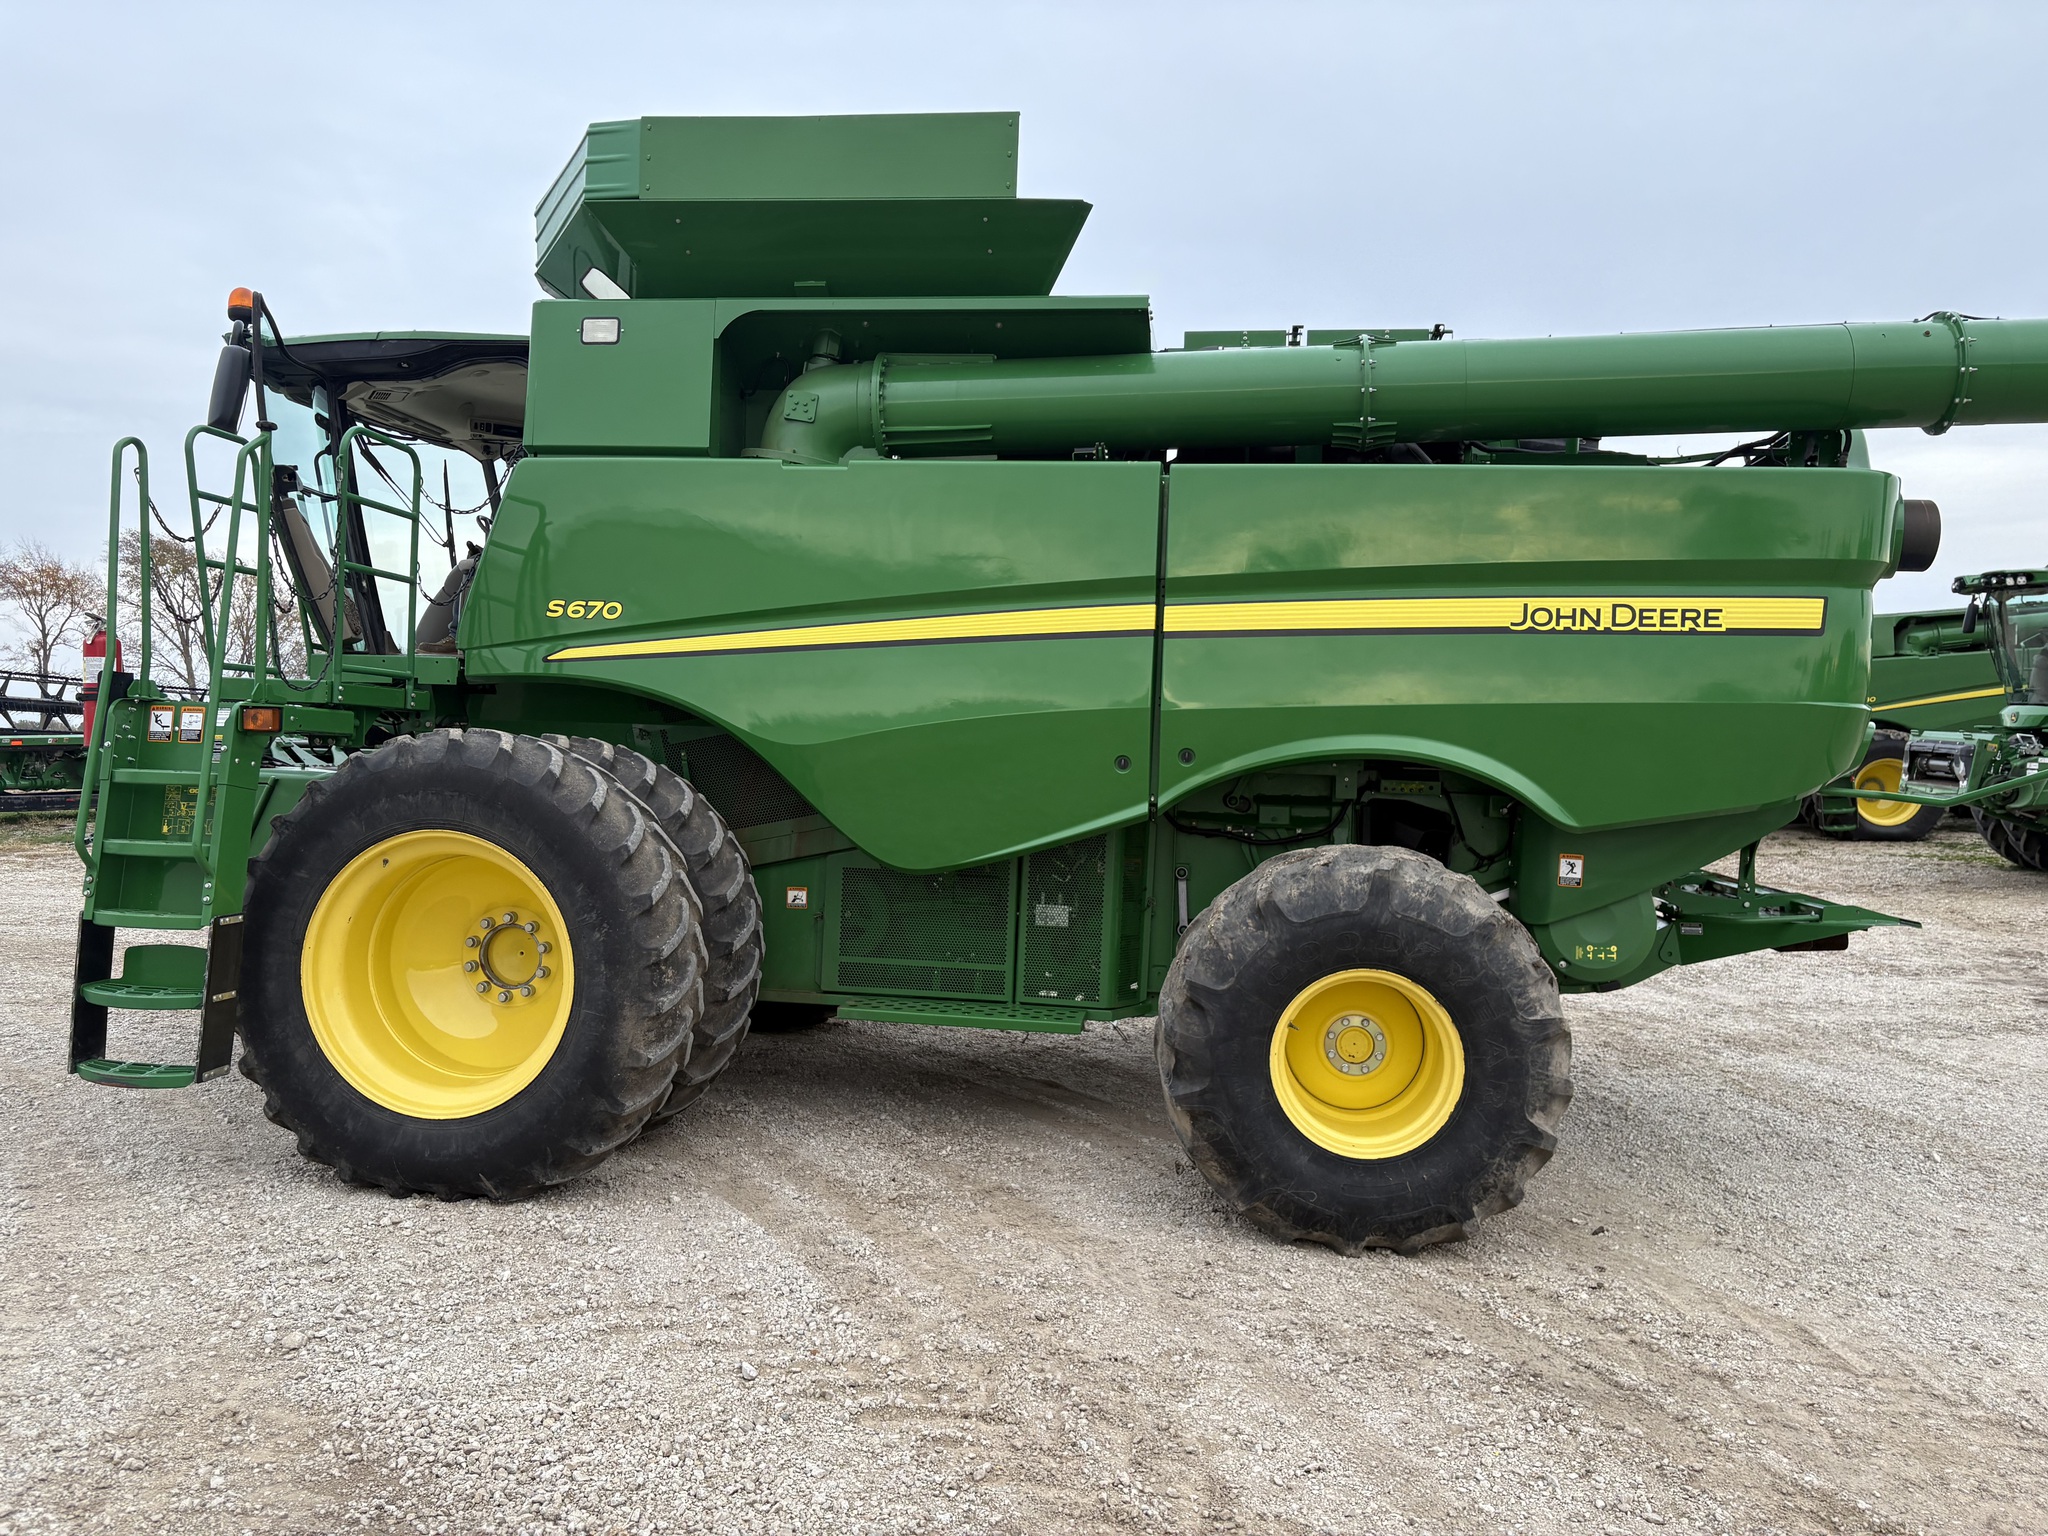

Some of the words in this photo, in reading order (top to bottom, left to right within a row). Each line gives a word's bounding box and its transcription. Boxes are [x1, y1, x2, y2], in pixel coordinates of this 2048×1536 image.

[545, 599, 623, 620] S670
[1510, 602, 1601, 628] JOHN
[1611, 603, 1724, 629] DEERE
